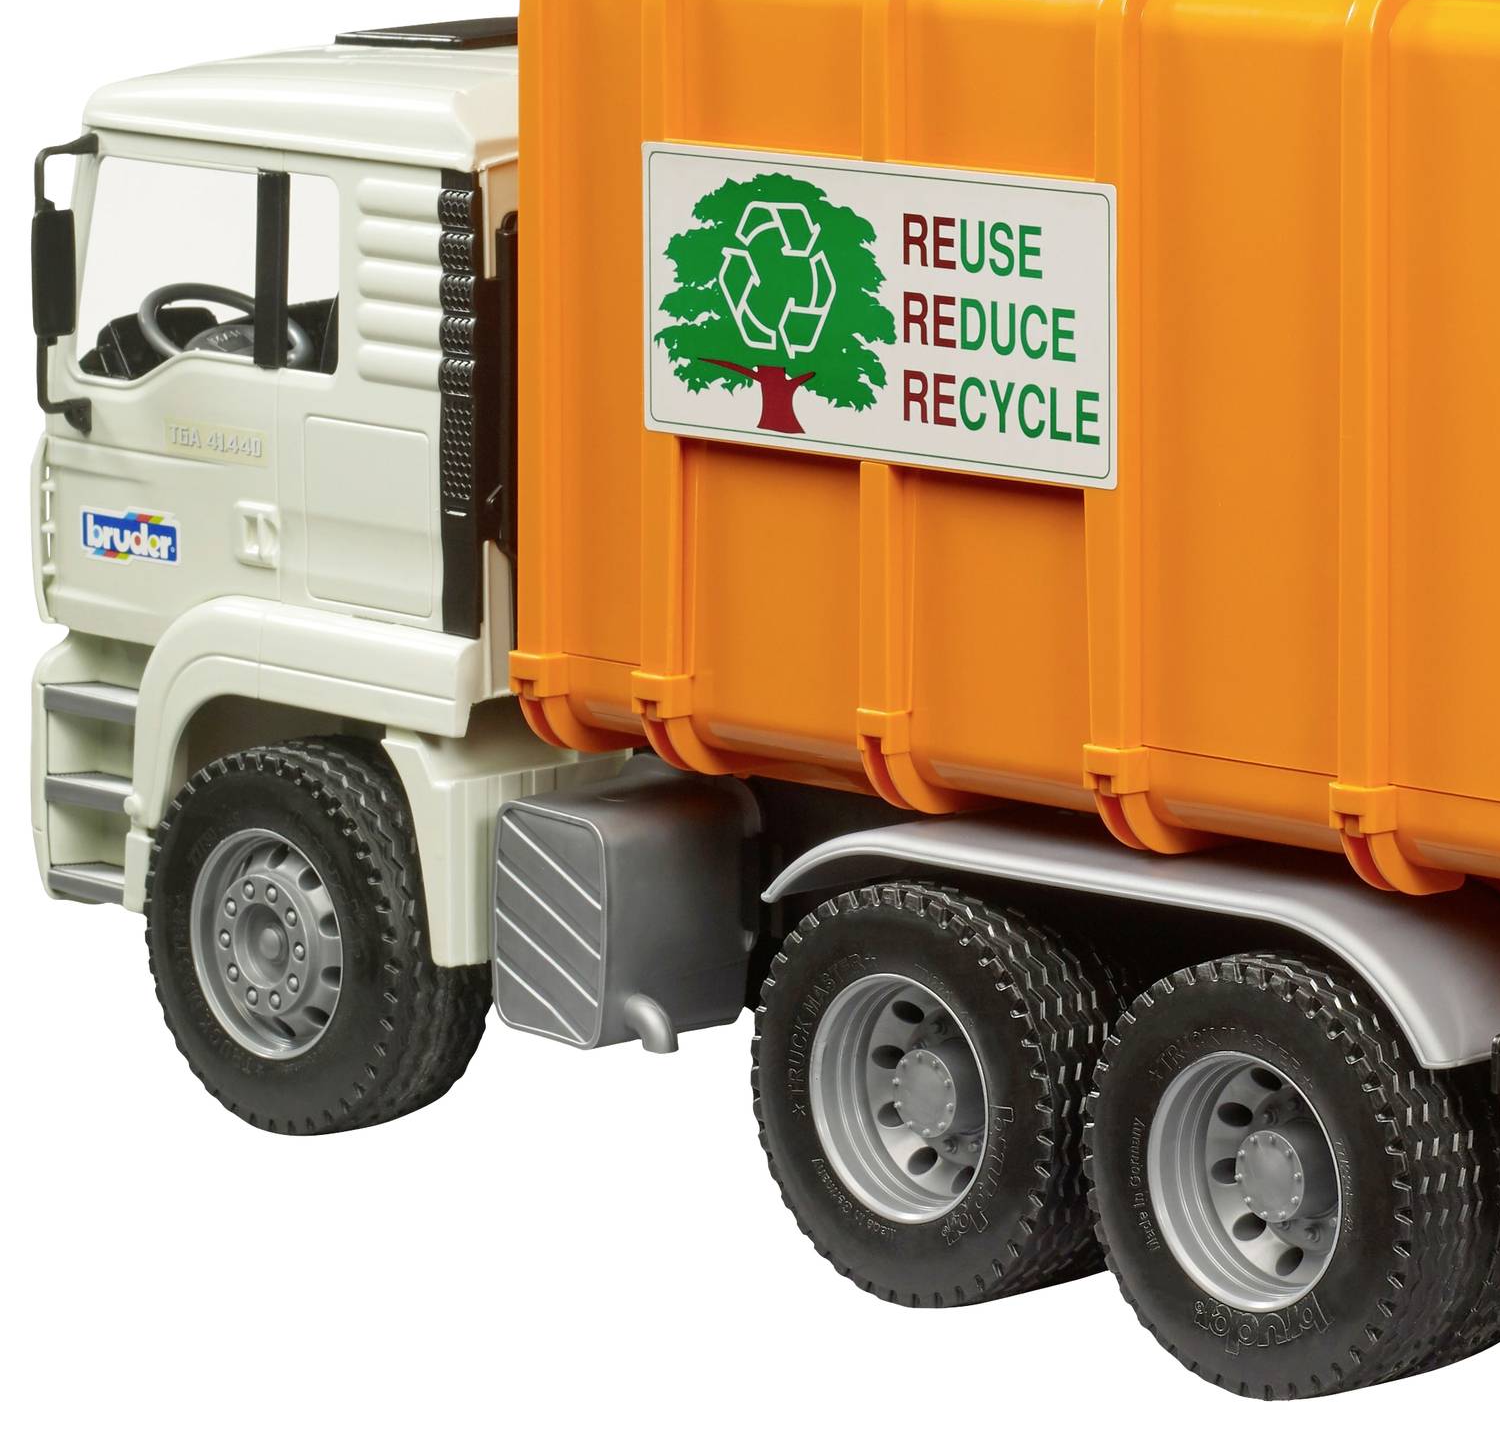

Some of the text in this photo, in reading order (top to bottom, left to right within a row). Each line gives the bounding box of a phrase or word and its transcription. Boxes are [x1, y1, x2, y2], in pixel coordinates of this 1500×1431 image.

[903, 213, 1044, 279] REUSE
[903, 291, 1077, 363] REDUCE
[169, 425, 202, 449] TGA
[903, 370, 1101, 446] RECYCLE
[86, 514, 173, 560] bruder
